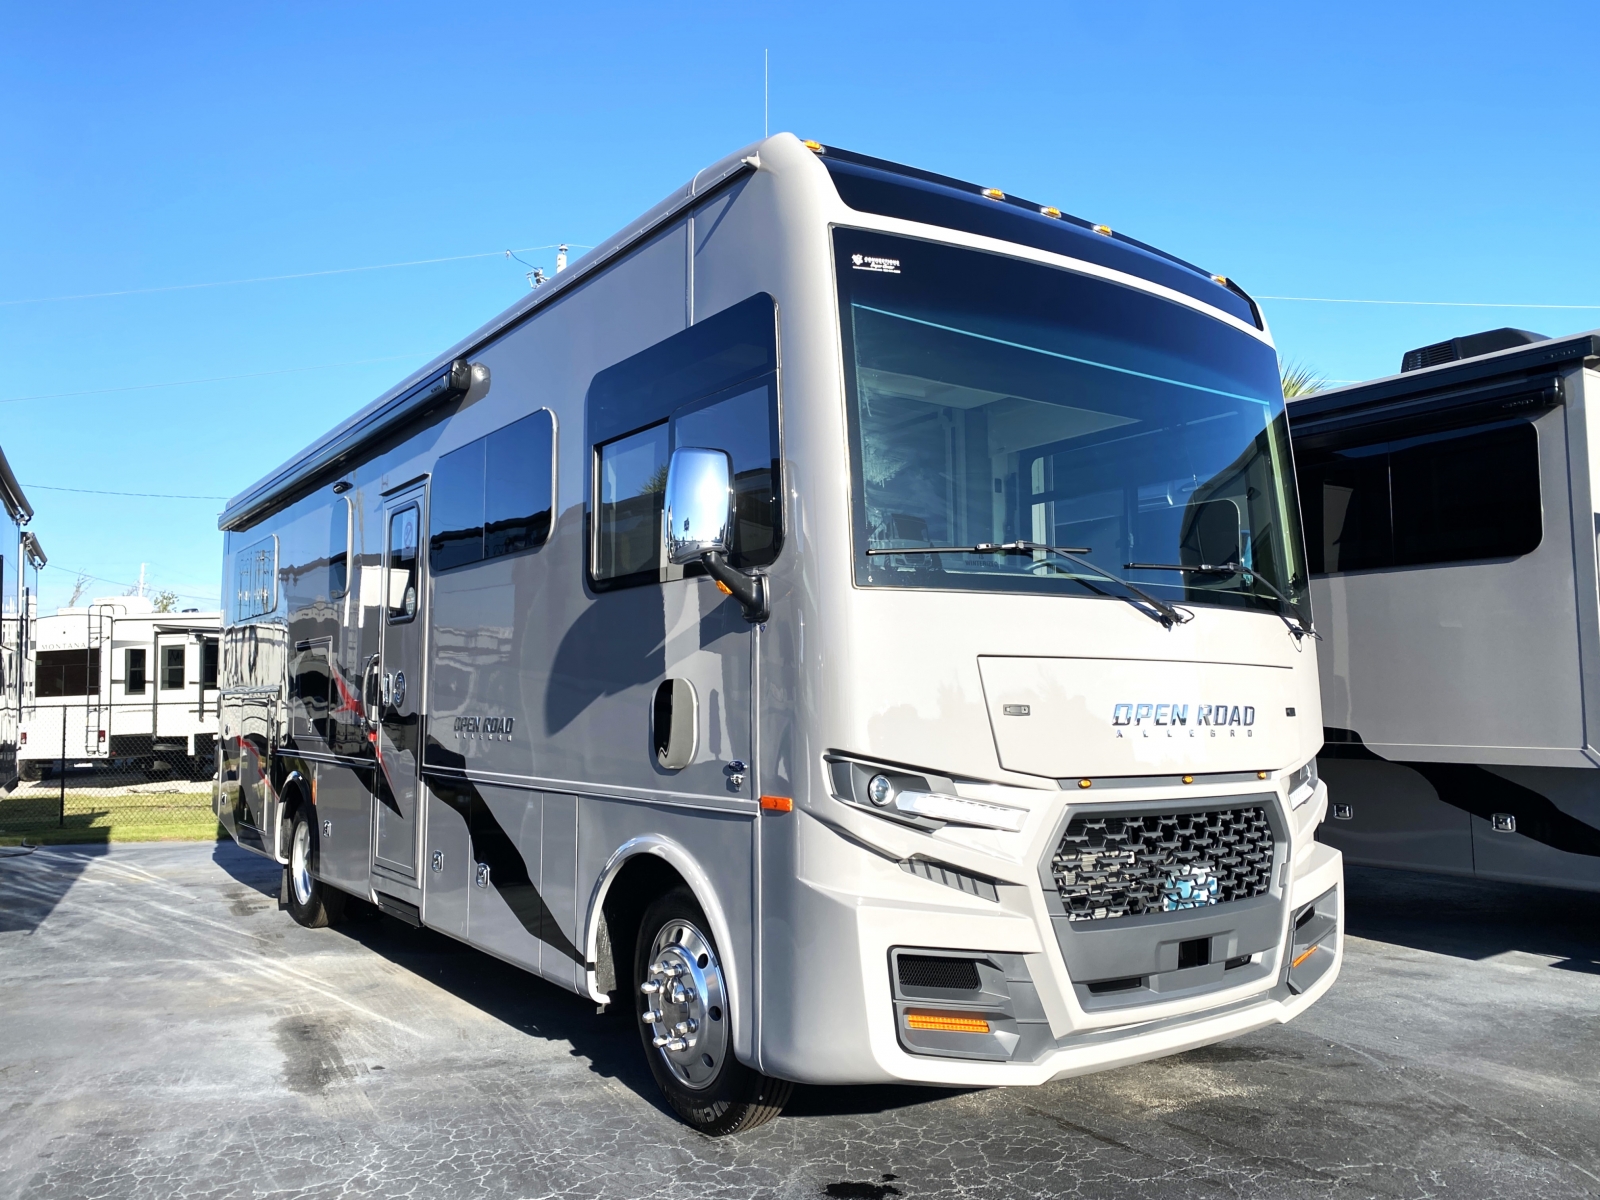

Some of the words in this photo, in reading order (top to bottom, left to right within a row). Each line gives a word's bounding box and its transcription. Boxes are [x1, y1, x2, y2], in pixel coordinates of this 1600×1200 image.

[41, 642, 86, 650] MONTANA
[1112, 703, 1189, 726] OPEN
[1197, 704, 1256, 727] ROAD
[453, 716, 481, 732] OPEN
[483, 717, 515, 734] ROAD
[1116, 729, 1253, 738] ALLEGRO
